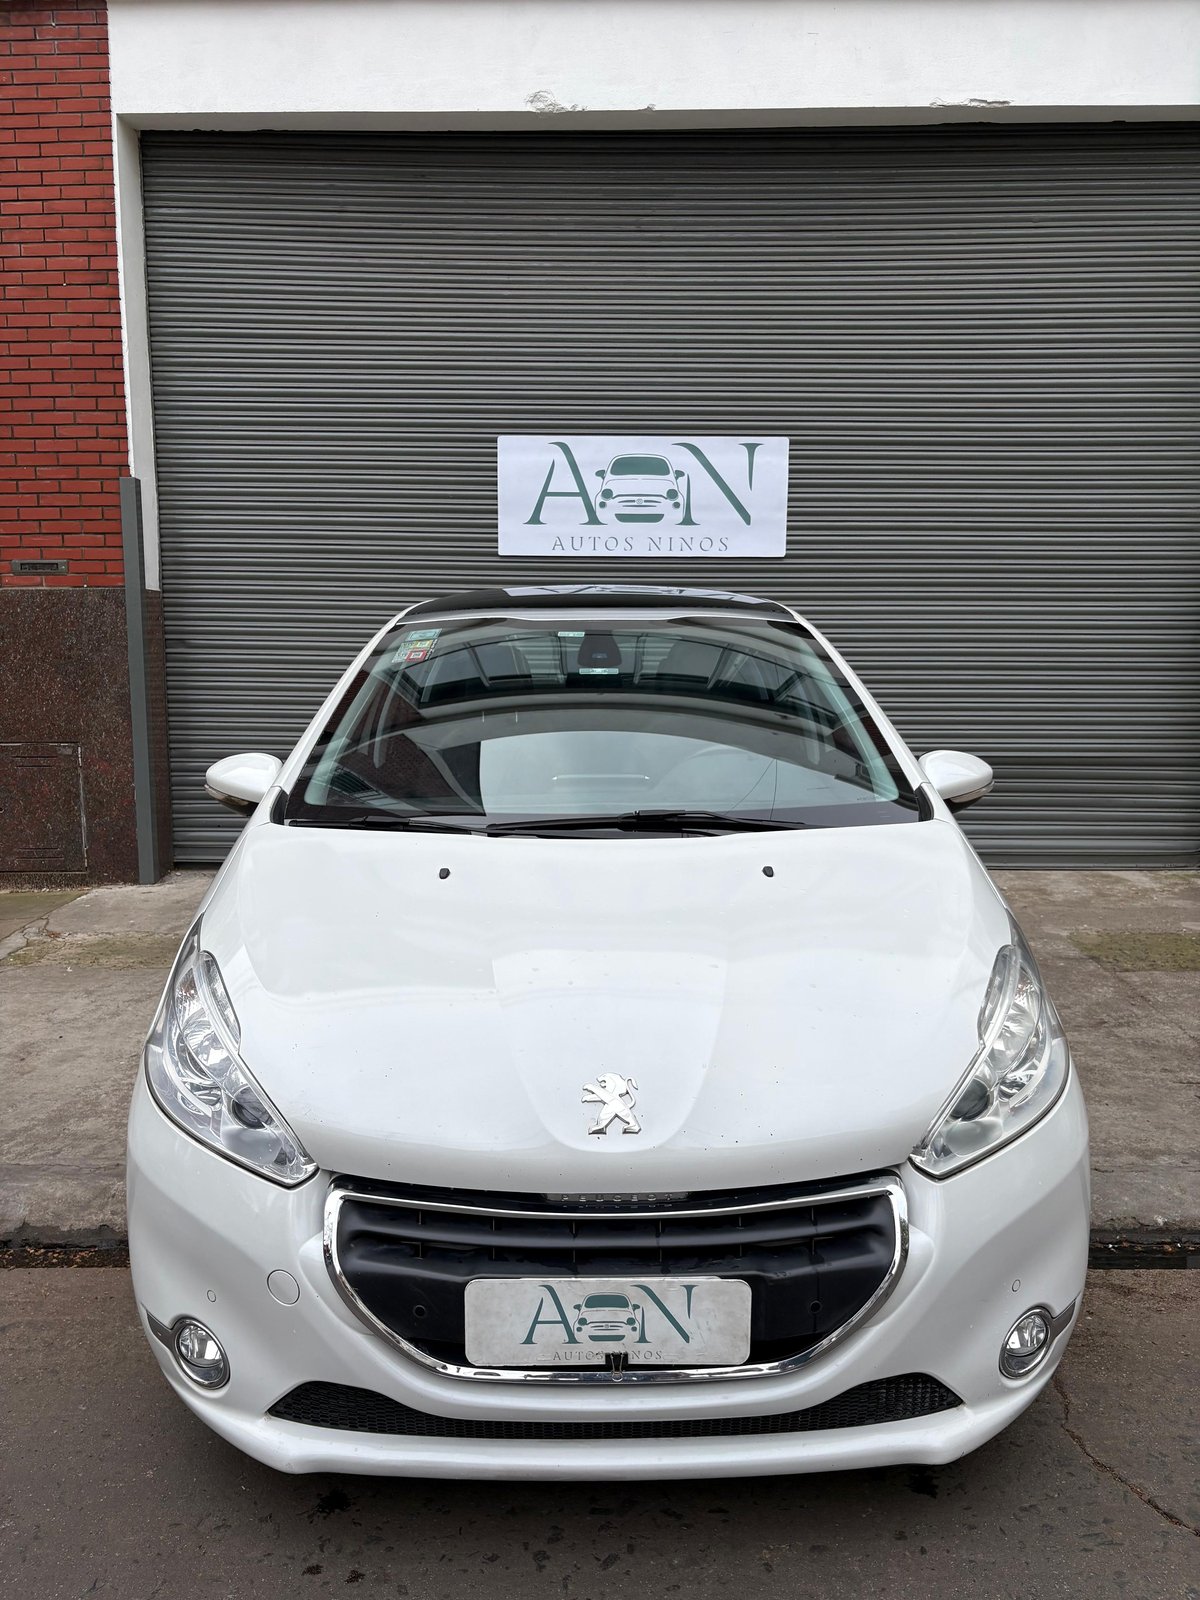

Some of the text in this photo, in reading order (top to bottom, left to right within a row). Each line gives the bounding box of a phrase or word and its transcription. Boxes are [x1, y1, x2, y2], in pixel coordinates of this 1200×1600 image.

[551, 535, 730, 552] AUTOS NINOS
[552, 1350, 605, 1361] AUTOS
